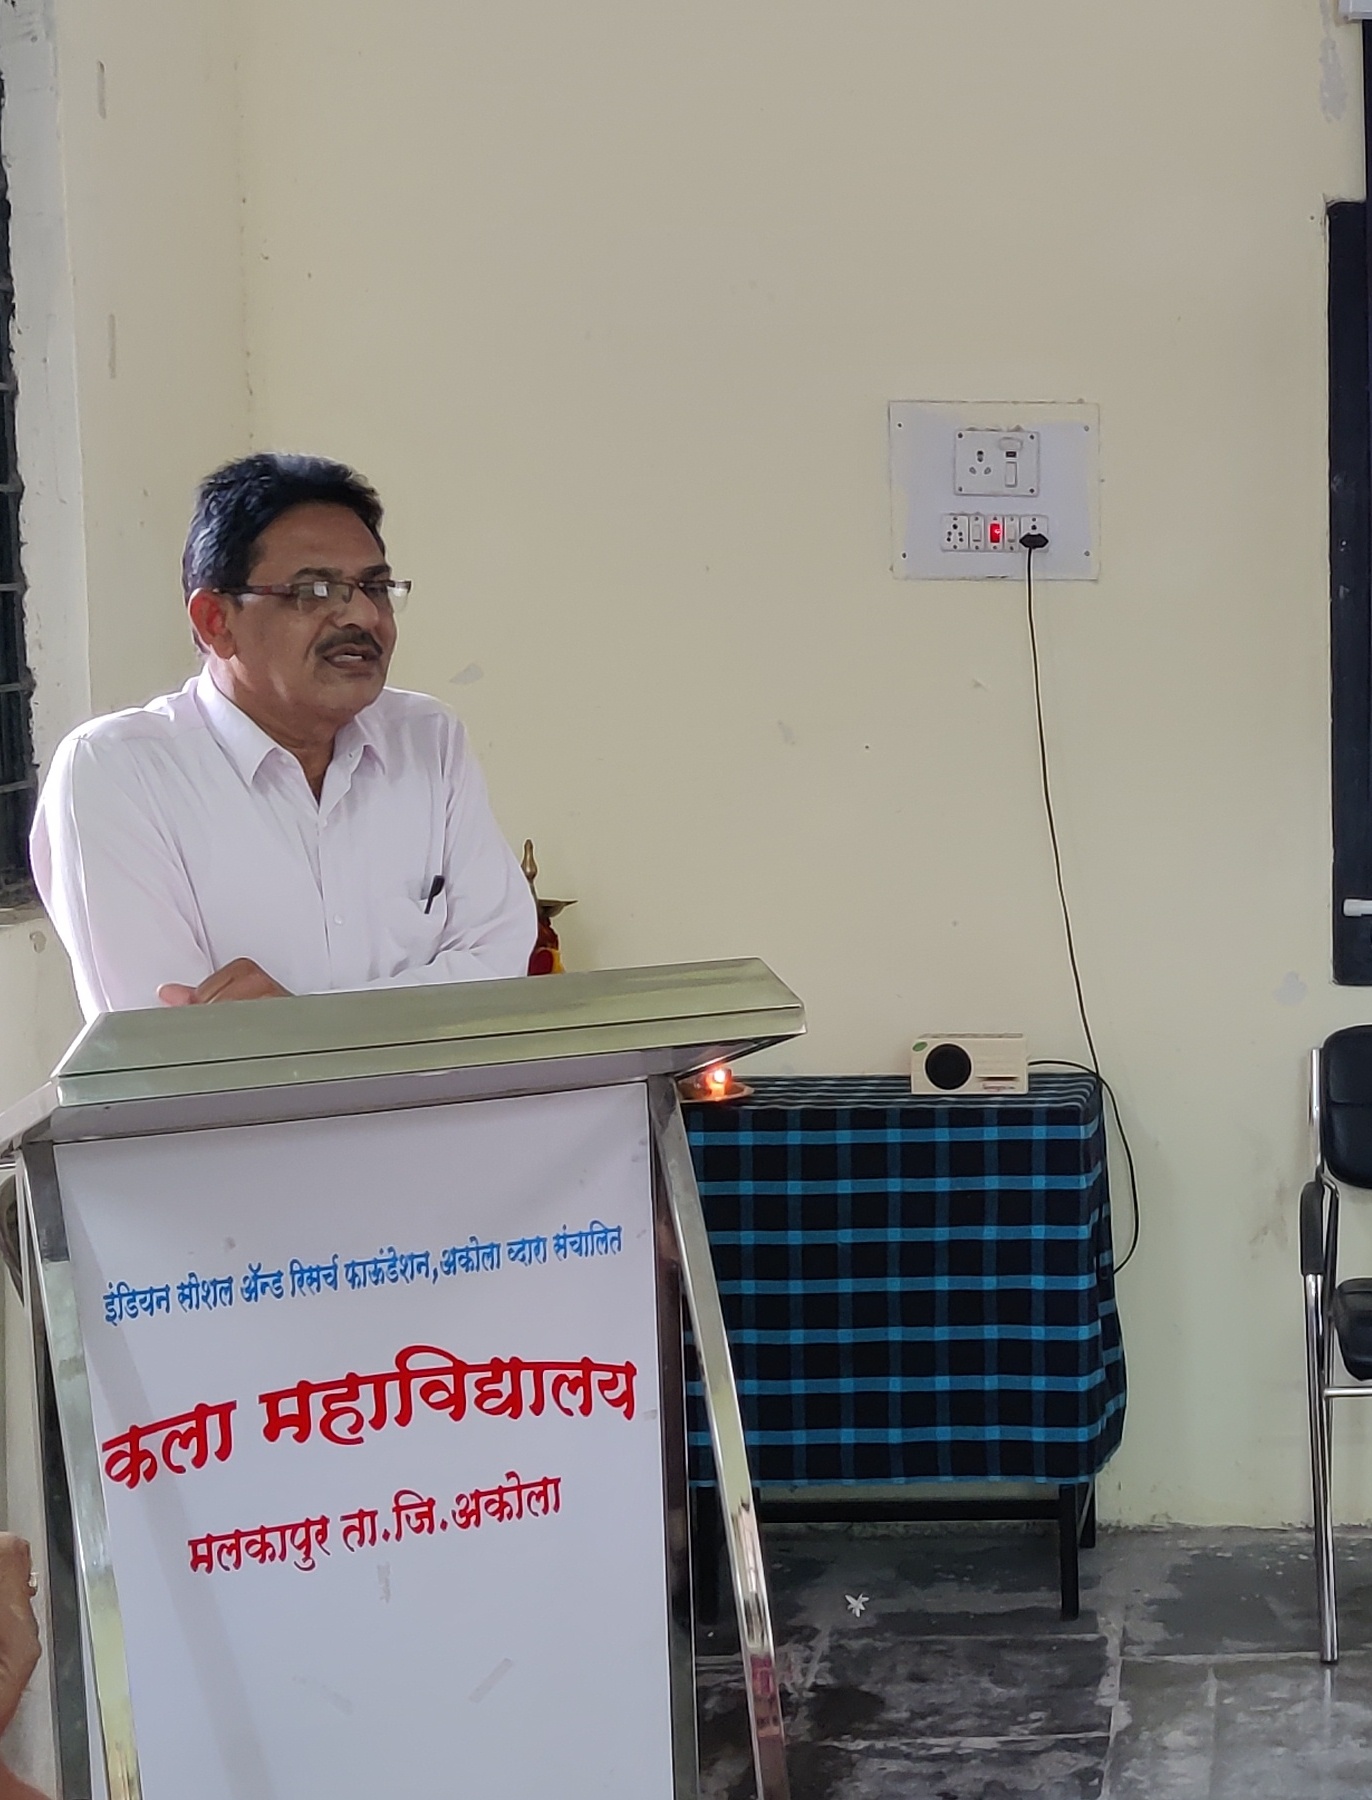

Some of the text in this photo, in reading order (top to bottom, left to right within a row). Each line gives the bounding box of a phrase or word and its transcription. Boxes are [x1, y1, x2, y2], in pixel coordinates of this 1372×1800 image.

[102, 1281, 171, 1326] इंडियन
[176, 1271, 234, 1313] सोशल
[289, 1253, 340, 1297] रिसर्च
[553, 1219, 623, 1261] संचालित
[101, 1344, 639, 1490] कला महाविद्यालय
[187, 1514, 331, 1574] मलकापुर
